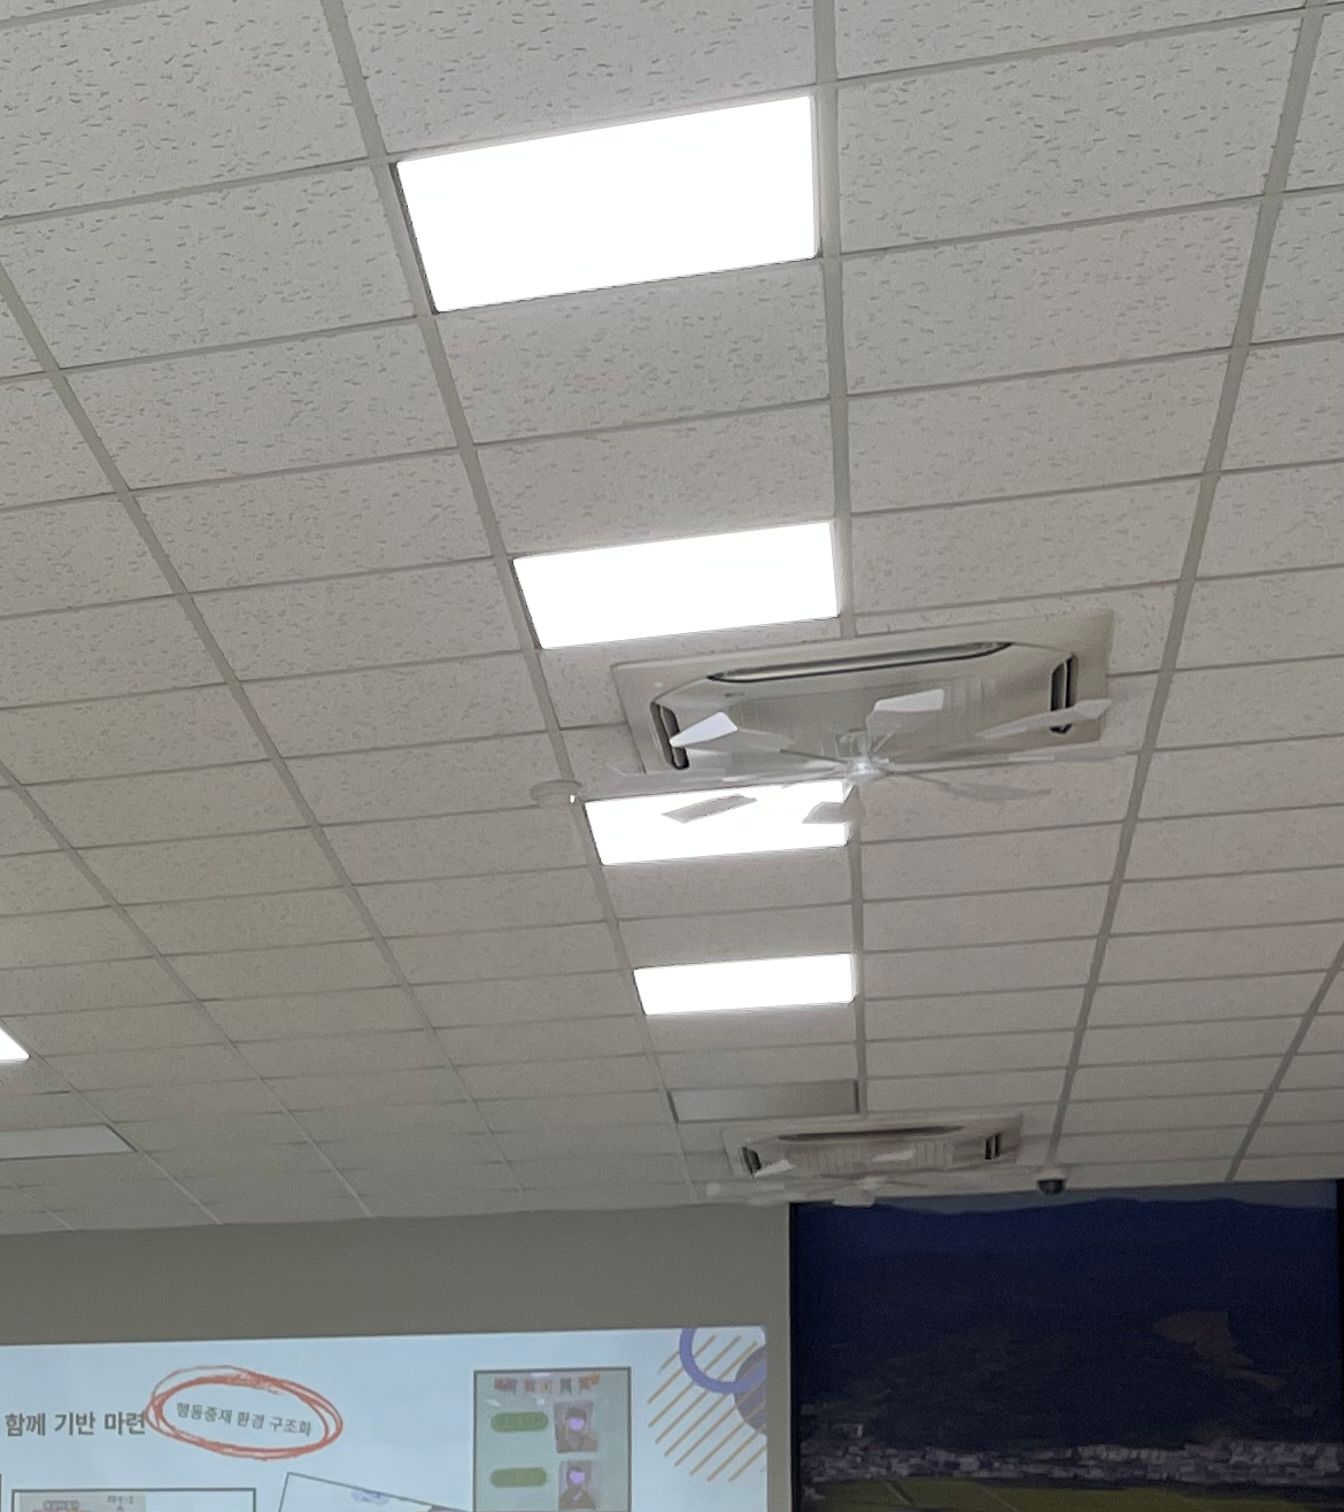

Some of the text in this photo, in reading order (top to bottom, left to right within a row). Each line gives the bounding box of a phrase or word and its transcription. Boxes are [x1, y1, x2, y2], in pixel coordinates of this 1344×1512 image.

[5, 1412, 47, 1437] 함께
[54, 1412, 96, 1436] 기반
[104, 1411, 147, 1436] 마련
[176, 1401, 312, 1438] 행동중재 환경 구조화
